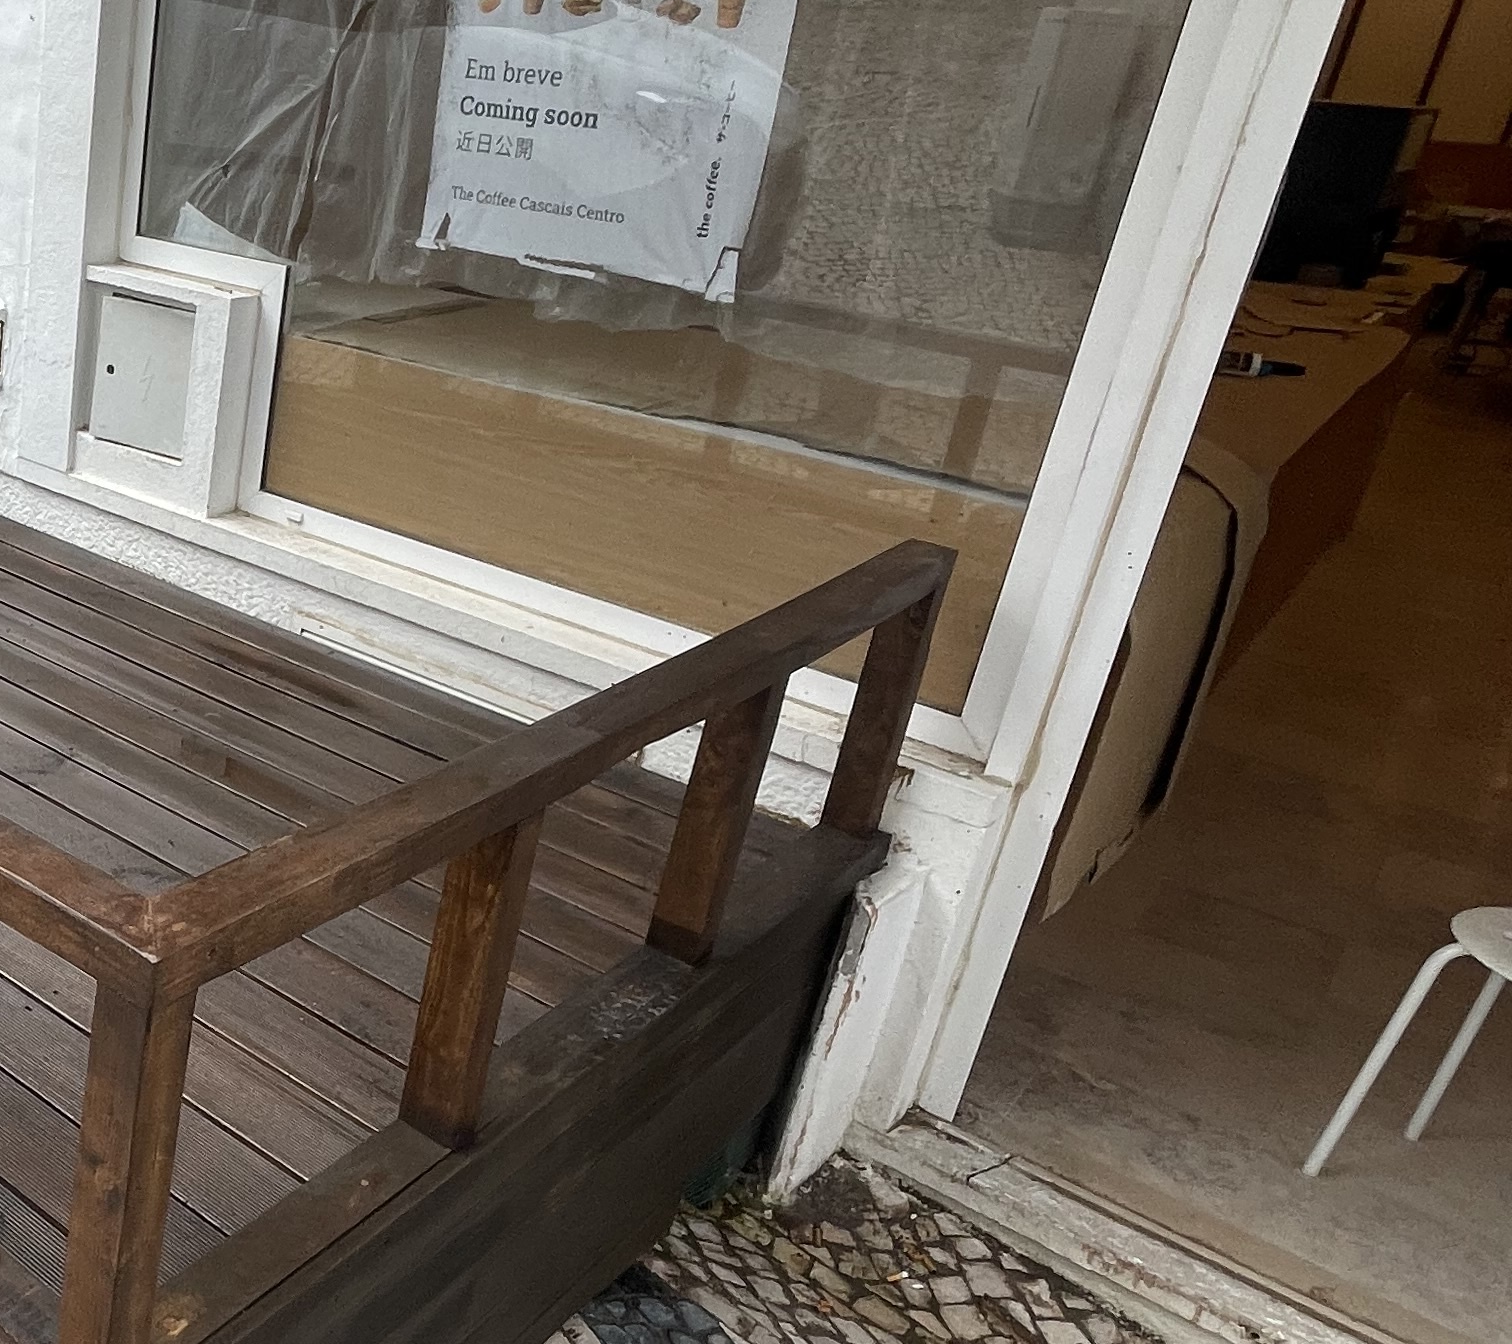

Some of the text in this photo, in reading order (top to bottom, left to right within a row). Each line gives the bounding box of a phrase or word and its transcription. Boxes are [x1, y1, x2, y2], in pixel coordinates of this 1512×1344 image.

[465, 58, 563, 87] Em breve
[460, 95, 598, 129] Coming soon
[456, 131, 534, 160] 近日公開
[451, 185, 624, 224] The Coffee Cascais Centro
[696, 212, 712, 239] the
